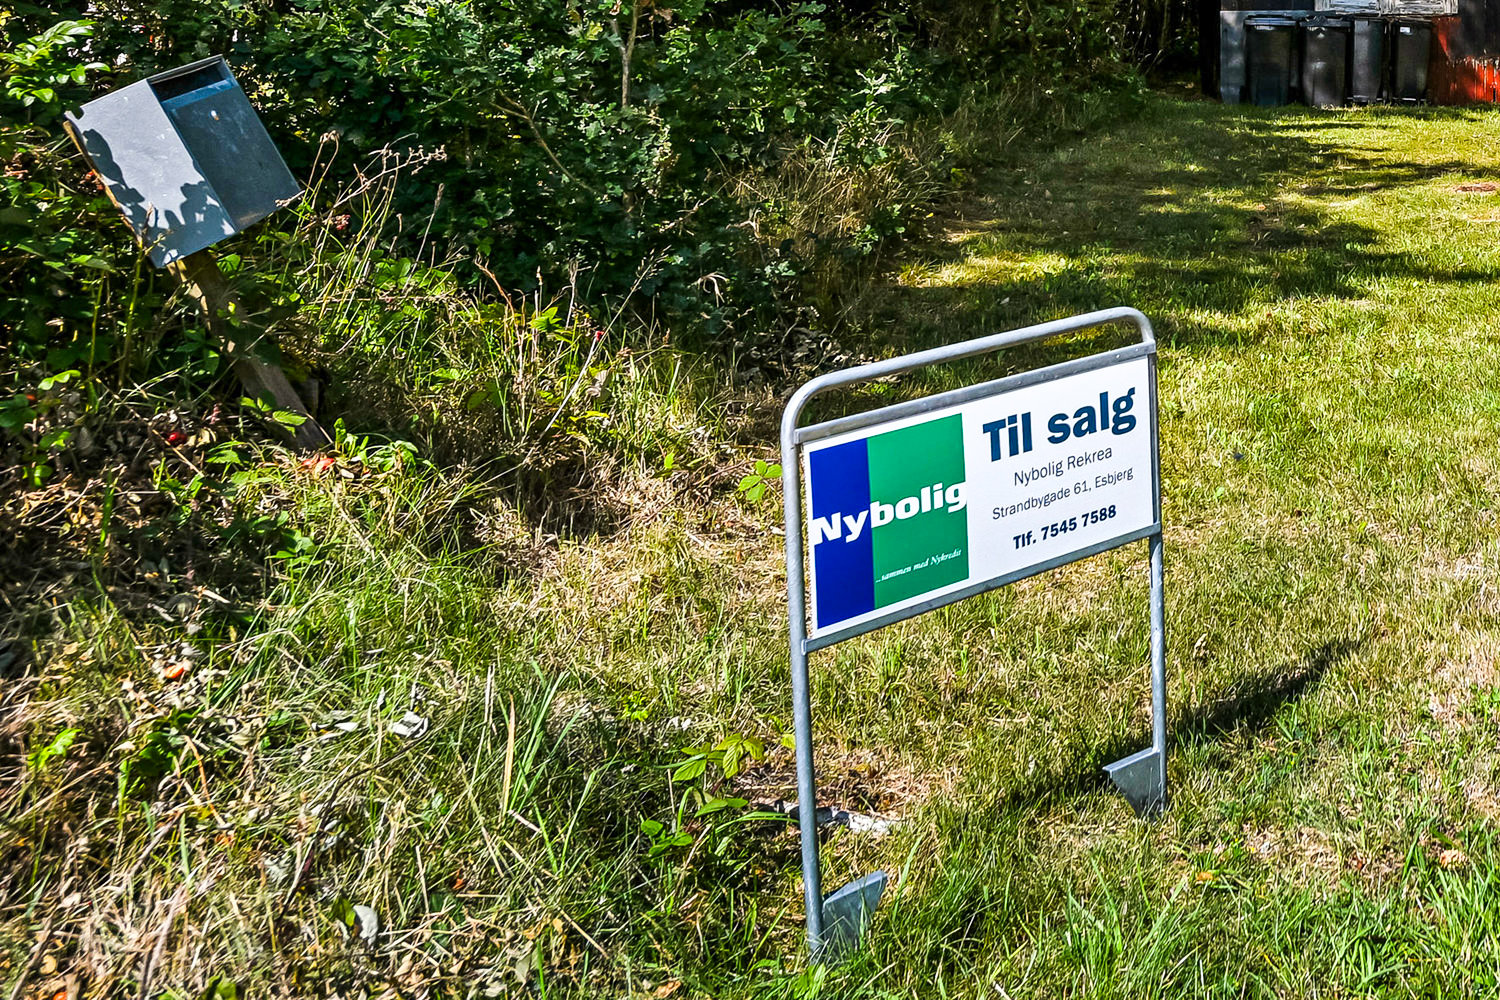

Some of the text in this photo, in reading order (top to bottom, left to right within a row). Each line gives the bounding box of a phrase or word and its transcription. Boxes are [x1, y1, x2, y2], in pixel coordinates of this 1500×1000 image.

[982, 386, 1137, 463] Til salg
[992, 467, 1134, 520] Strandbygade 61, Esbjerg
[1014, 447, 1113, 487] Nybolig Rekrea
[812, 481, 967, 546] Nybolig
[1013, 504, 1117, 550] Tlf. 7545 7588
